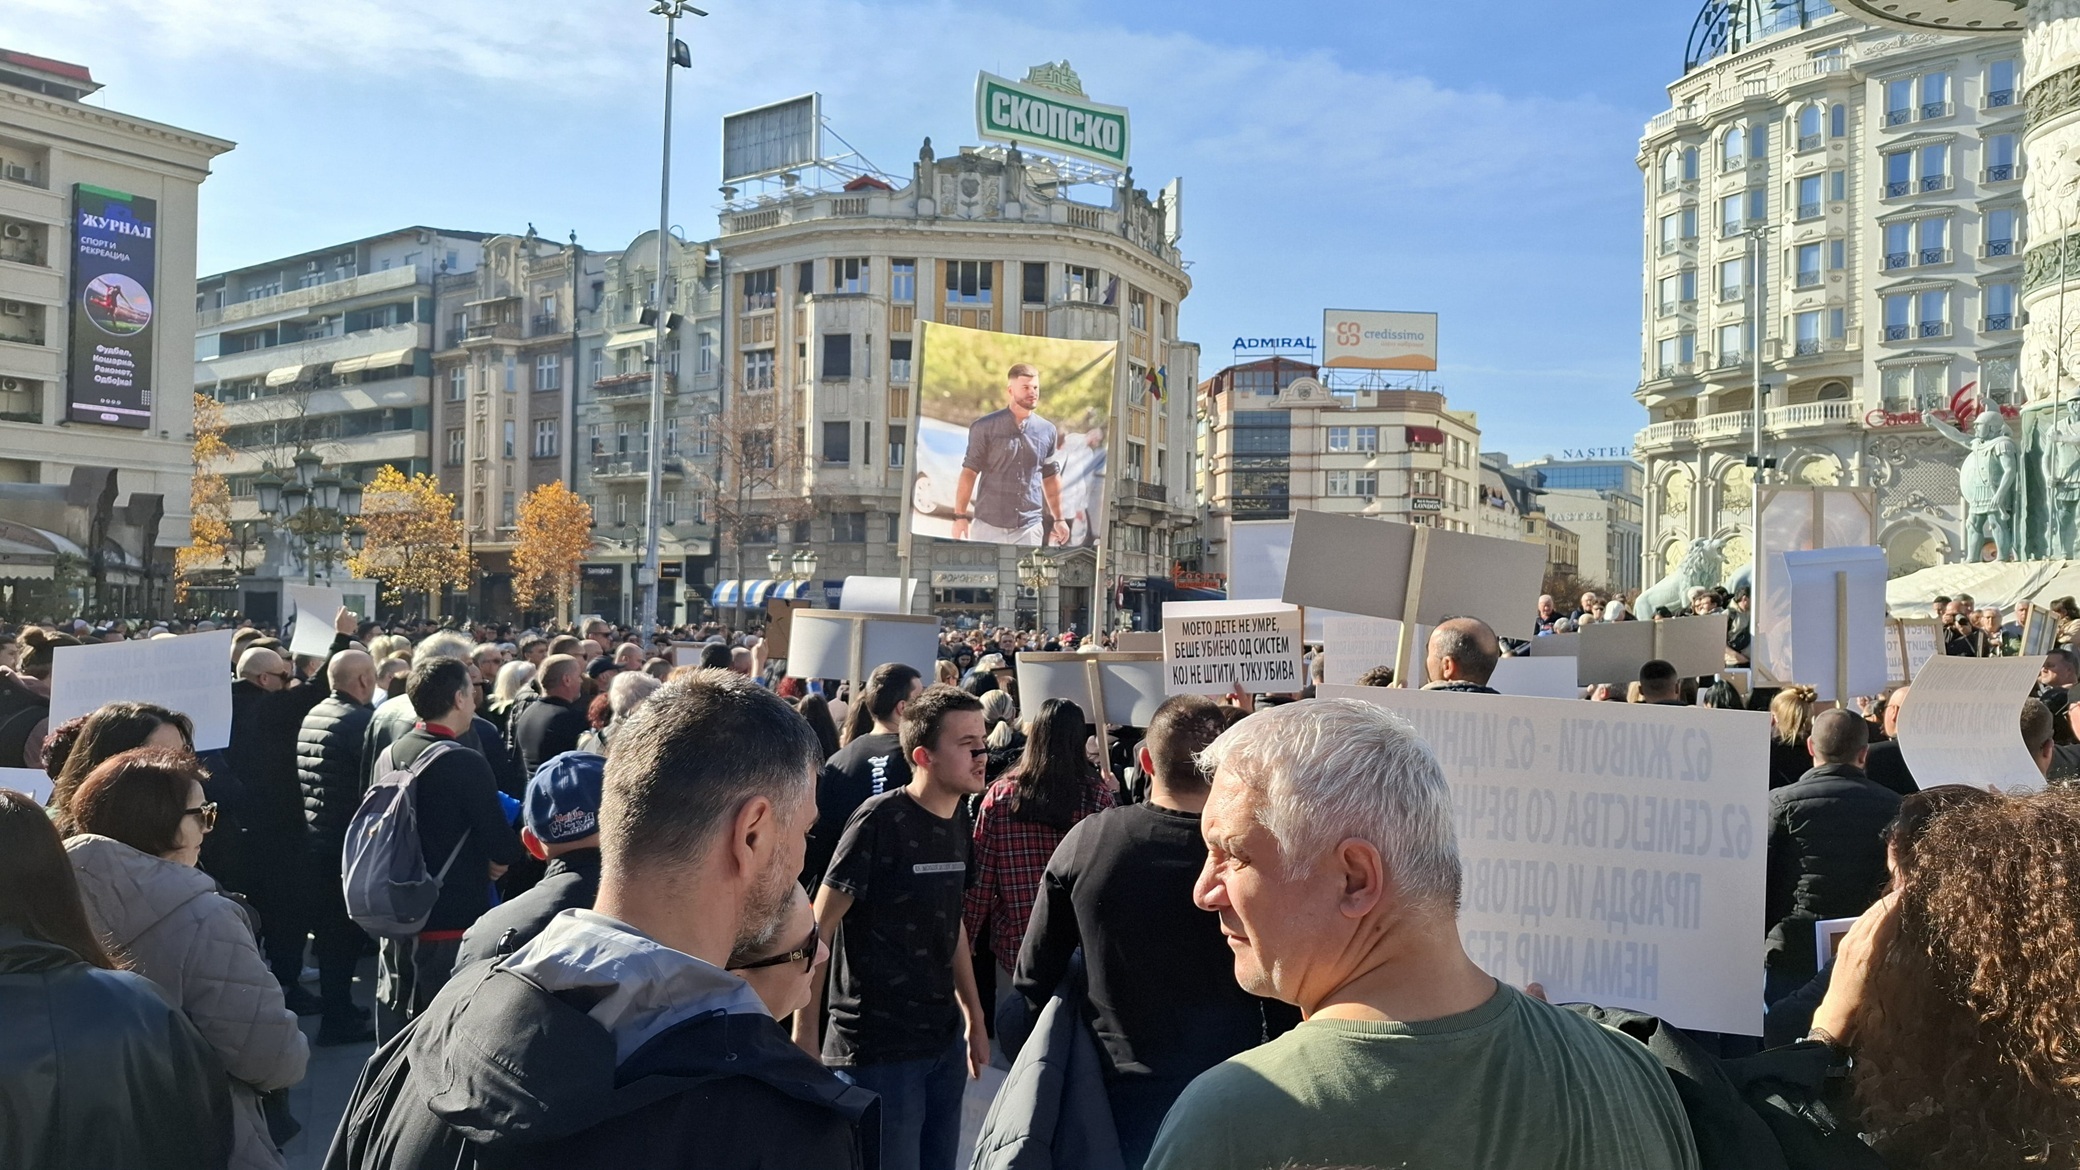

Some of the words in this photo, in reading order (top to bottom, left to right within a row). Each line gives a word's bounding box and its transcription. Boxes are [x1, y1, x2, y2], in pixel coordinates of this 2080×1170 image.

[991, 91, 1121, 153] СКОПСКО
[82, 213, 152, 239] ЖУРНАЛ
[81, 236, 108, 248] СПОРТ
[109, 242, 117, 250] И
[80, 245, 131, 262] РЕКРЕАЦИЈА
[1364, 328, 1425, 341] credissimo
[1232, 336, 1317, 350] ADMIRAL
[1563, 446, 1630, 459] NASTEL
[1414, 502, 1440, 510] LONDON
[1545, 511, 1604, 522] NASTEL
[1182, 620, 1212, 636] МОЕТО
[1214, 619, 1237, 637] ДЕТЕ
[1238, 618, 1250, 634] НЕ
[1252, 617, 1280, 635] УМРЕ,
[1174, 641, 1200, 659] БЕШЕ
[1202, 639, 1237, 657] УБИЕНО
[1239, 638, 1253, 659] ОД
[1254, 636, 1290, 655] СИСТЕМ
[1172, 665, 1189, 685] КОЈ
[1190, 665, 1202, 684] НЕ
[1203, 663, 1239, 684] ШТИТИ,
[1240, 661, 1263, 682] ТУКУ
[1264, 660, 1295, 681] УБИВА
